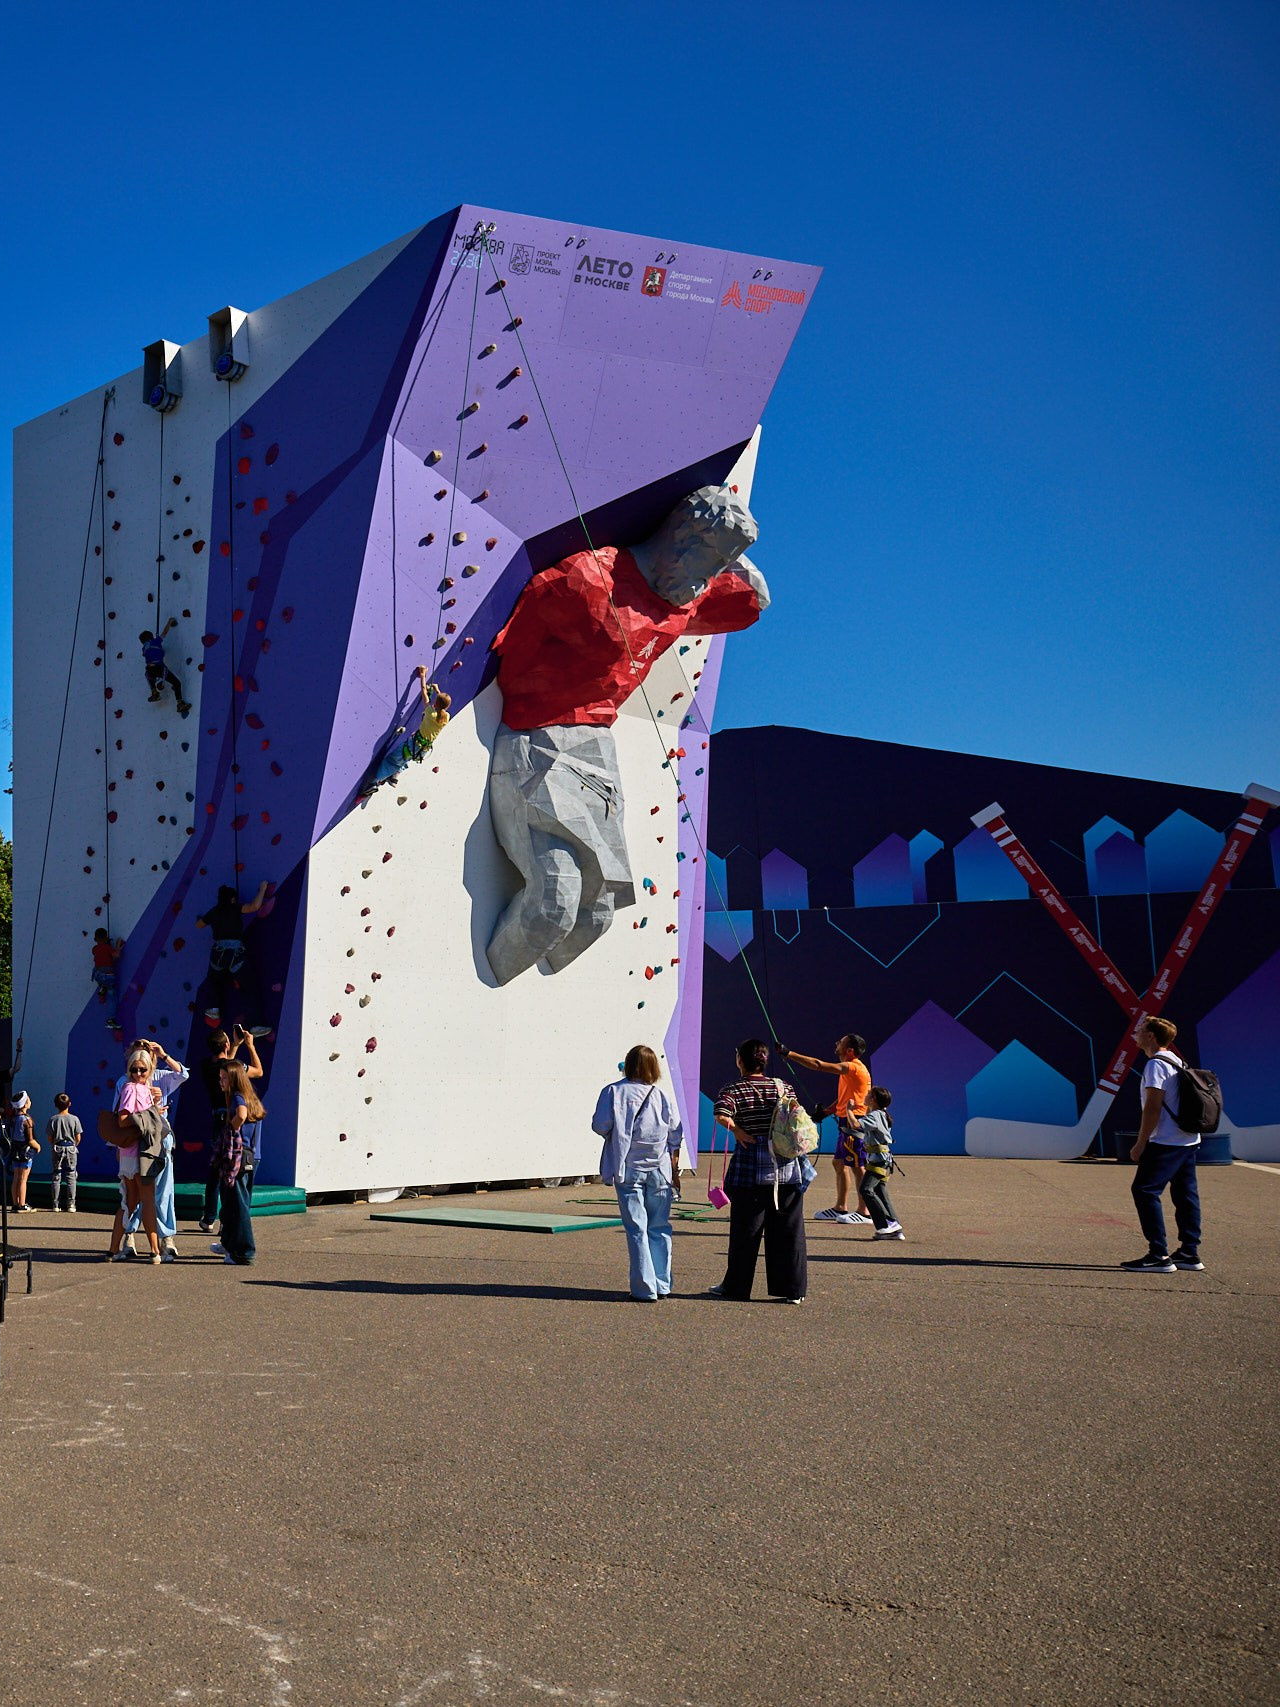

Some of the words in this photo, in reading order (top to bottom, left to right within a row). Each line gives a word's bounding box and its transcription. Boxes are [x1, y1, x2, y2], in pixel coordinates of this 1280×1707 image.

[536, 251, 561, 260] ПРОЕКТ
[535, 259, 553, 267] МЭРА
[577, 255, 634, 278] ЛЕТО
[534, 266, 561, 275] МОСКВЫ
[574, 274, 582, 283] В
[584, 276, 630, 291] МОСКВЕ
[669, 271, 713, 284] Департамент
[667, 282, 691, 291] спорта
[665, 290, 689, 301] города
[689, 293, 715, 304] Москвы
[747, 283, 806, 305] МОСКОВСКИЙ
[744, 298, 773, 315] СПОРТ
